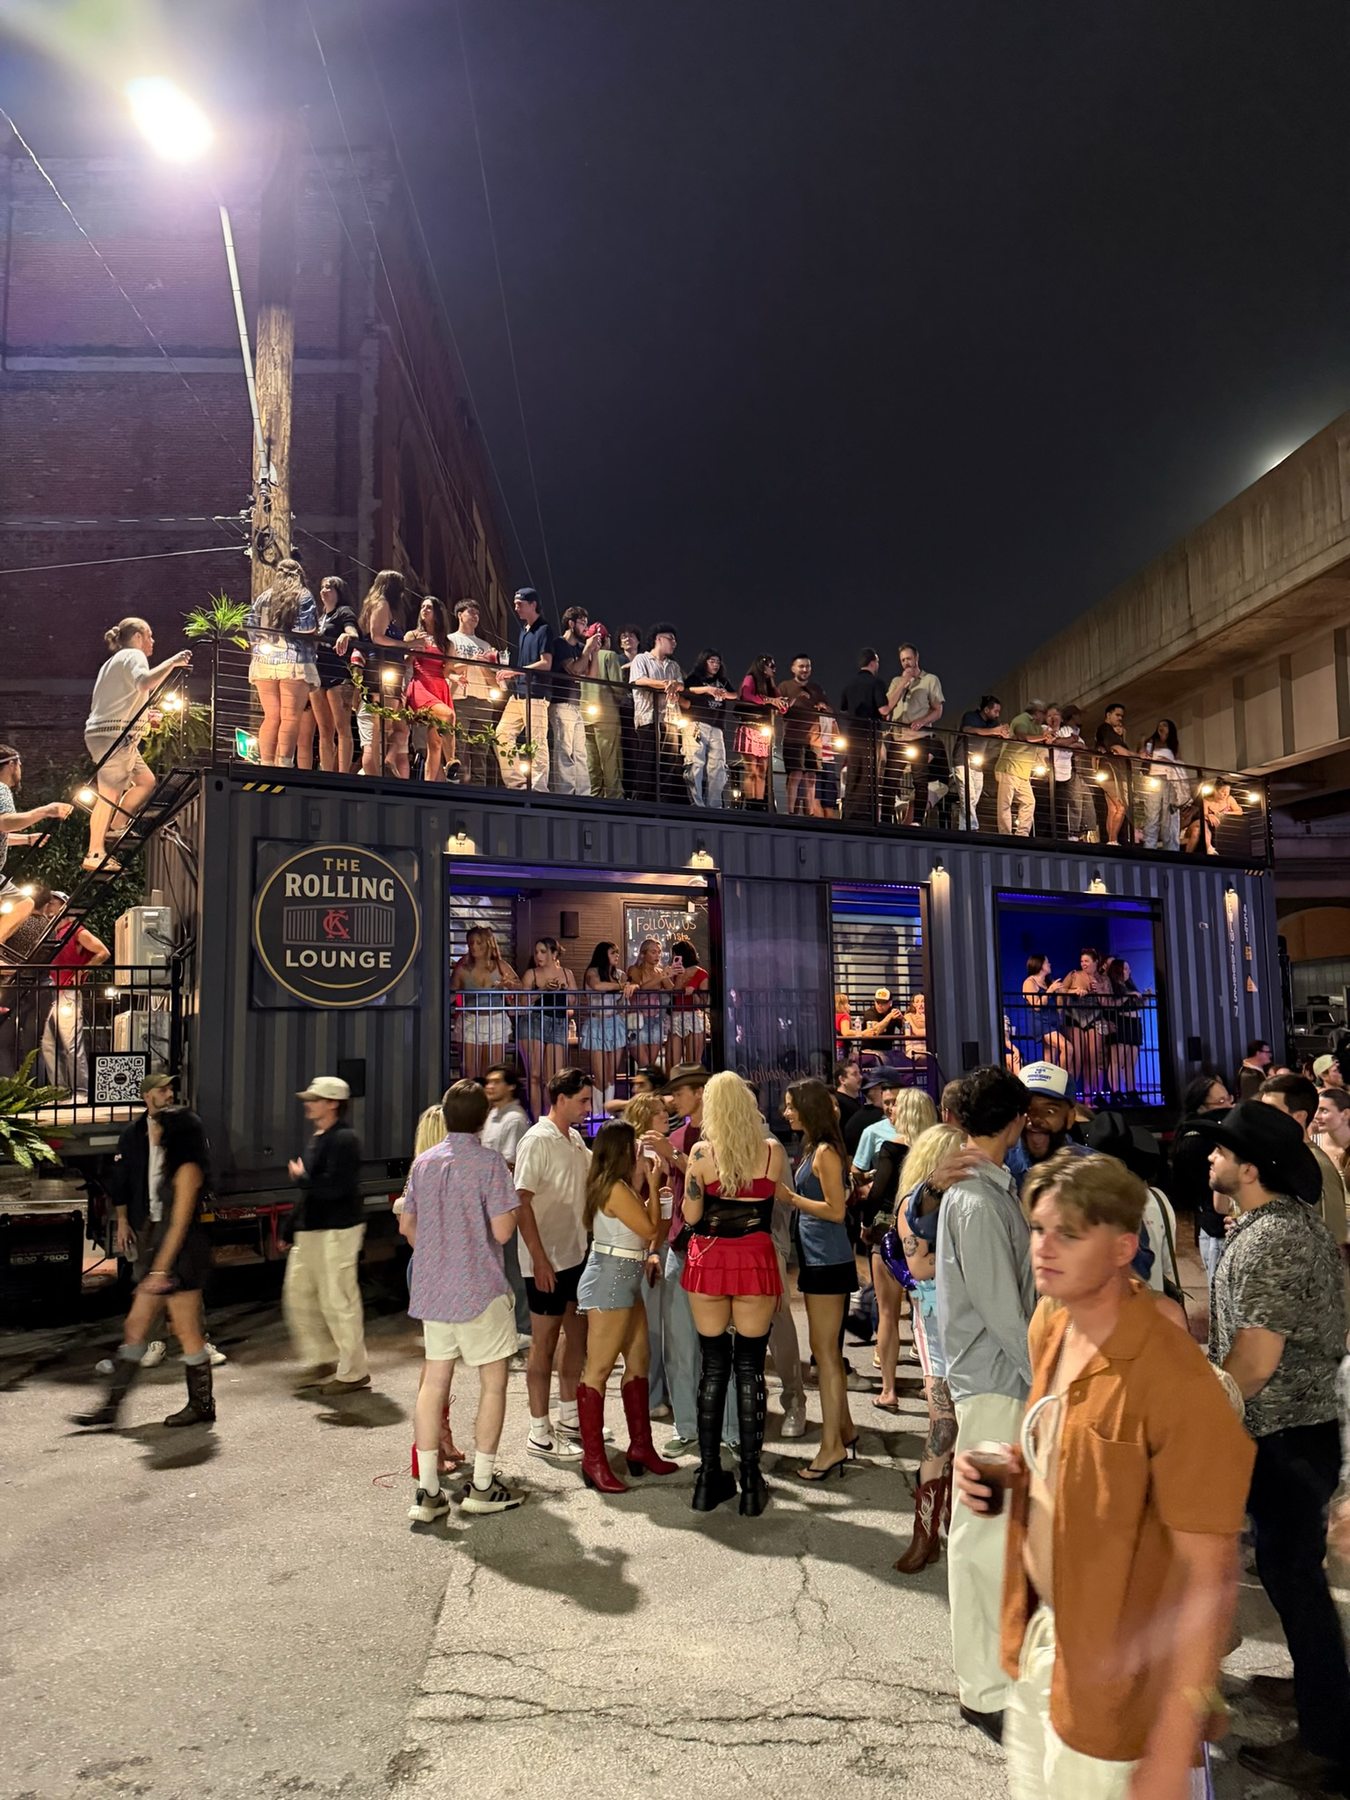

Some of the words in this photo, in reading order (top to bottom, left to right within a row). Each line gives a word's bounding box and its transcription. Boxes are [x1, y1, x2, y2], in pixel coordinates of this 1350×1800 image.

[323, 857, 361, 873] THE
[284, 872, 395, 902] ROLLING
[285, 949, 392, 969] LOUNGE
